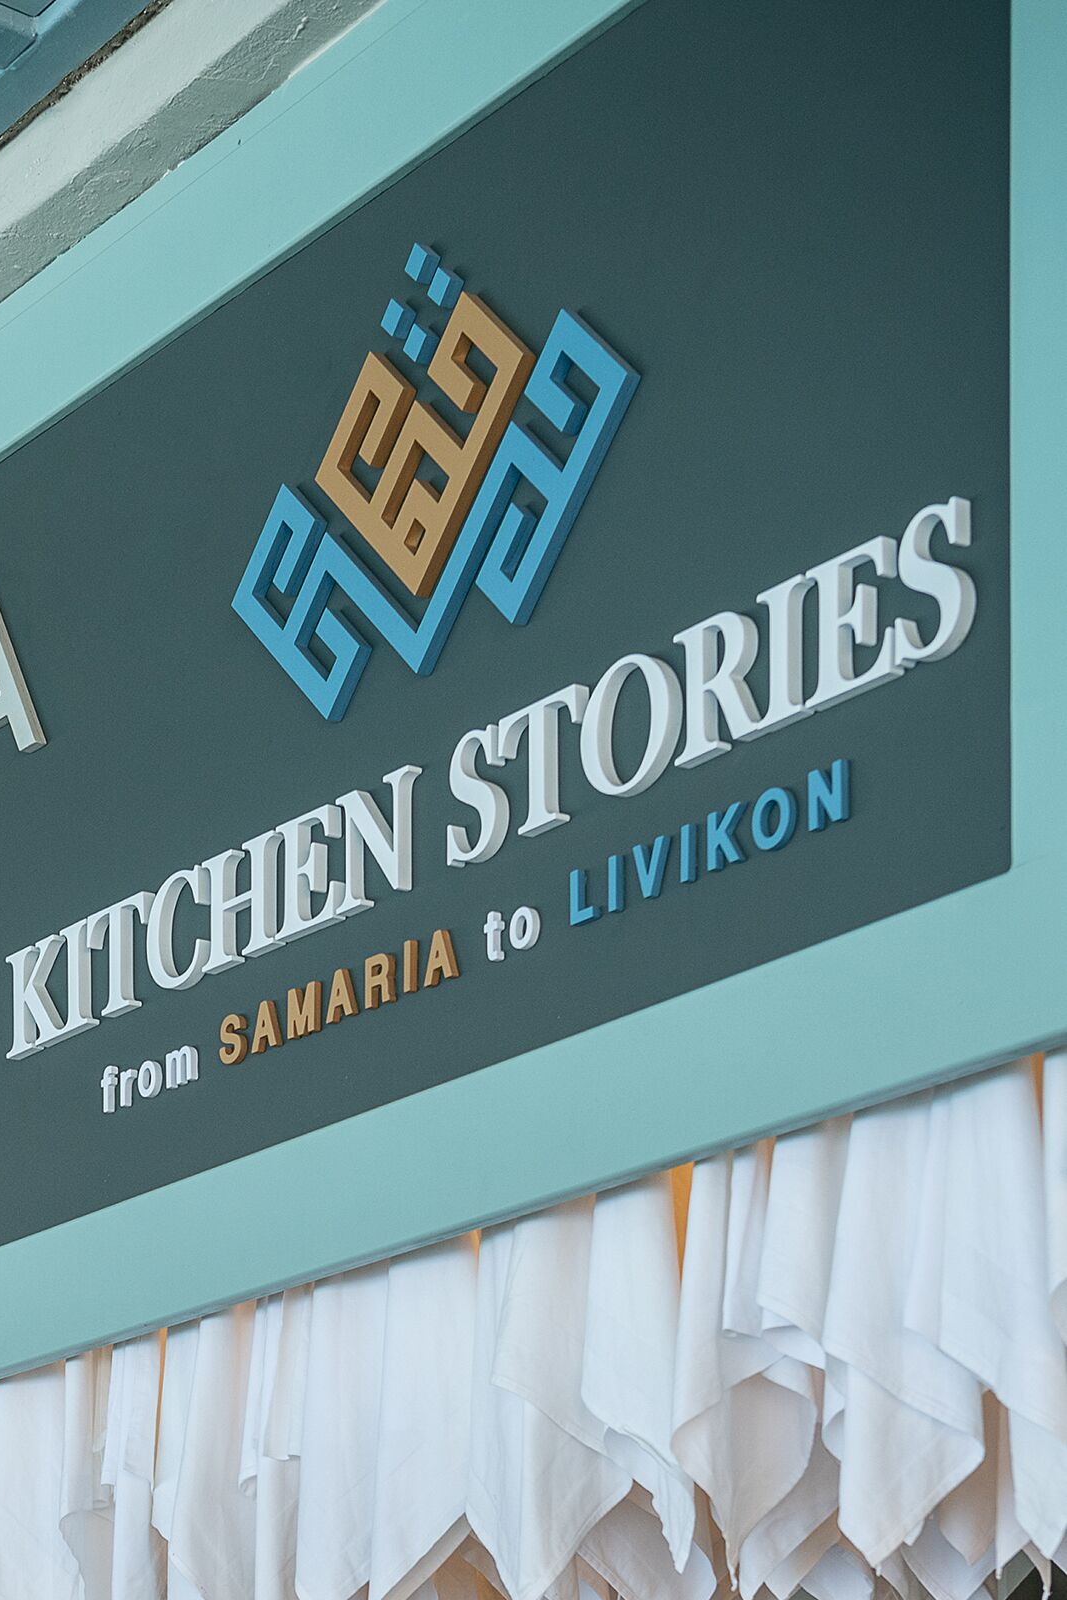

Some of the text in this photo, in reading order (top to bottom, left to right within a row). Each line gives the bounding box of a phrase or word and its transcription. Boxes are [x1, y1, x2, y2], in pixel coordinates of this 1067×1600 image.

[5, 496, 977, 1062] KITCHEN STORIES
[99, 757, 852, 1113] from SAMARIA to LIVIKON
